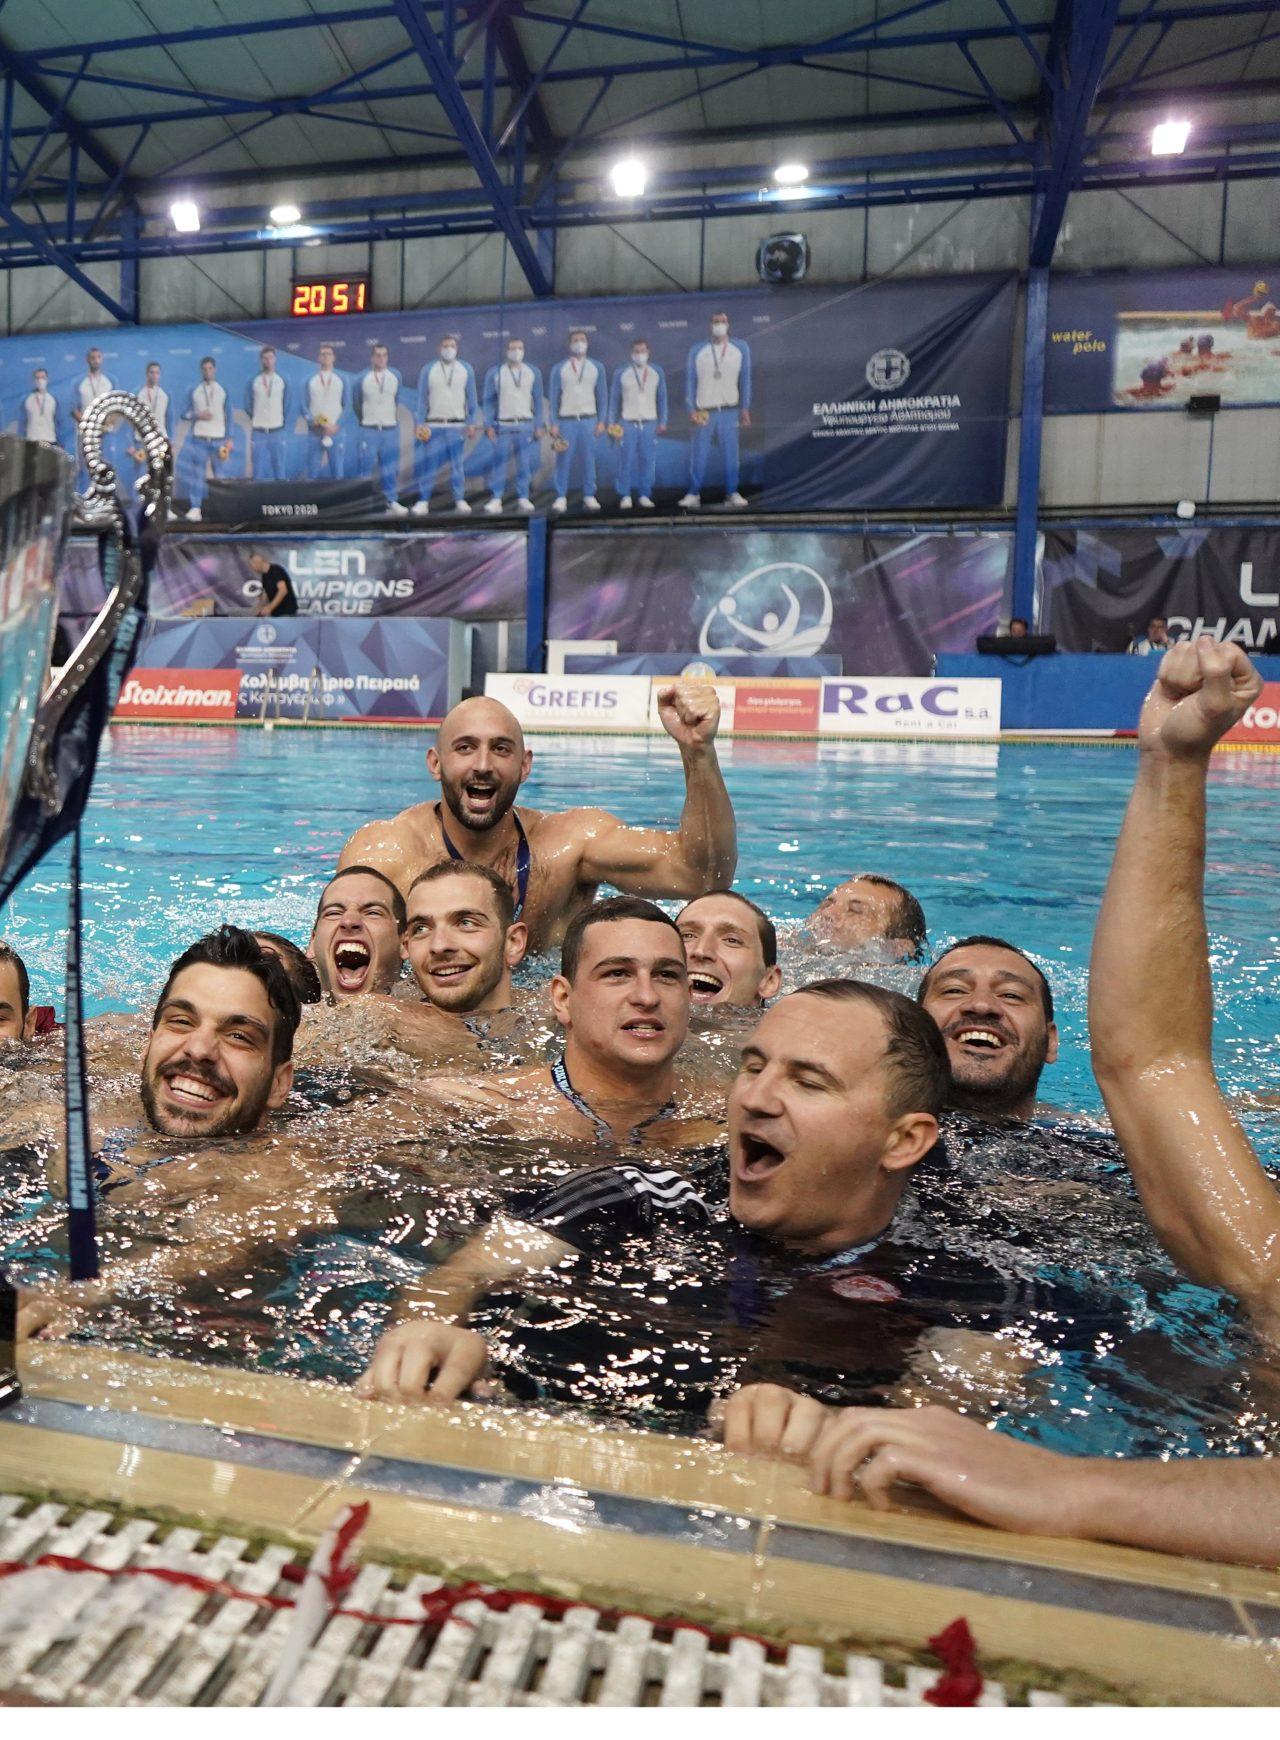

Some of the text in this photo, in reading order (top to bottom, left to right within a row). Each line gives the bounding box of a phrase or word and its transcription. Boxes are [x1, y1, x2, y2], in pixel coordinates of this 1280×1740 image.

[813, 394, 961, 416] ΕΛΛΗΝΙΚΗ ΔΗΜΟΚΡΑΤΙΑ
[261, 504, 293, 516] TOKYO
[242, 579, 415, 598] CMPIONS
[297, 600, 375, 615] EAGUE
[357, 674, 420, 691] Πειραιά
